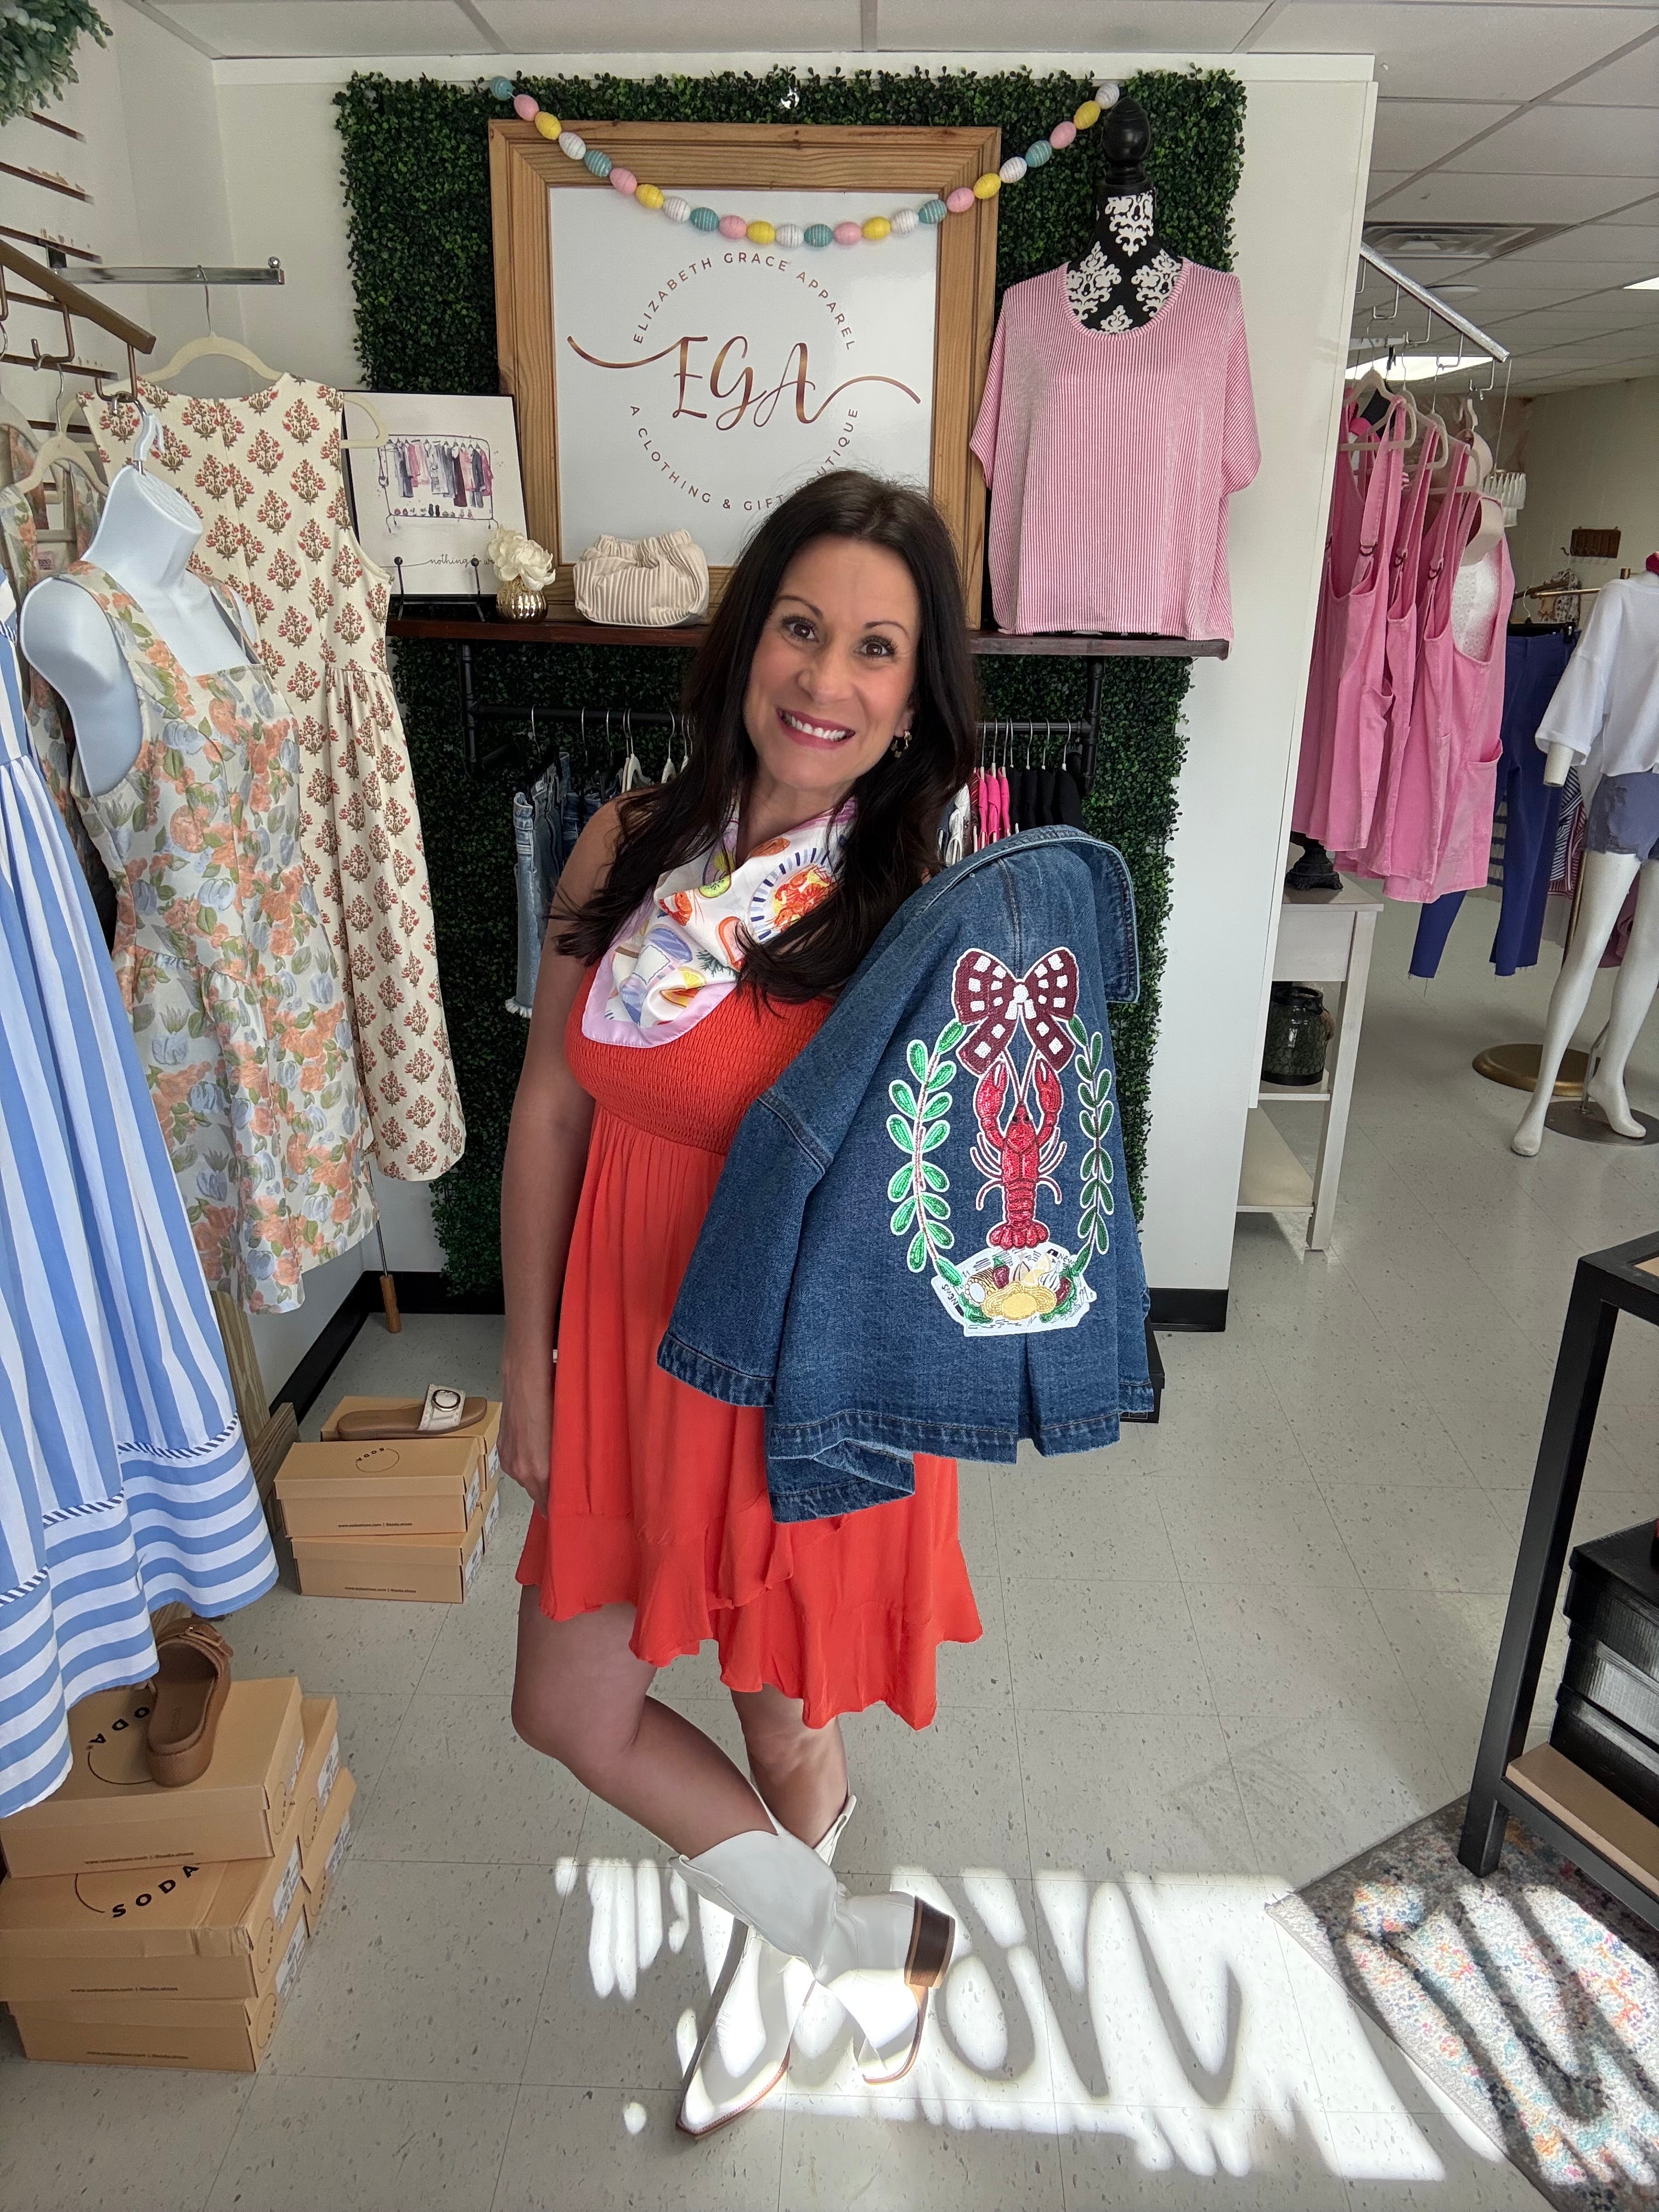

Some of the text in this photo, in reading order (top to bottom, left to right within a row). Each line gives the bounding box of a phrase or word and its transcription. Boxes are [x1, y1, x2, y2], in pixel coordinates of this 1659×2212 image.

[633, 252, 855, 351] ELIZABETH GRACE APPAREL
[630, 405, 858, 511] A CLOTHING & GIFT UTIQUE
[427, 553, 470, 568] nothing
[356, 1447, 385, 1462] SODA
[89, 1706, 151, 1744] ODA
[112, 1865, 200, 1918] SODA
